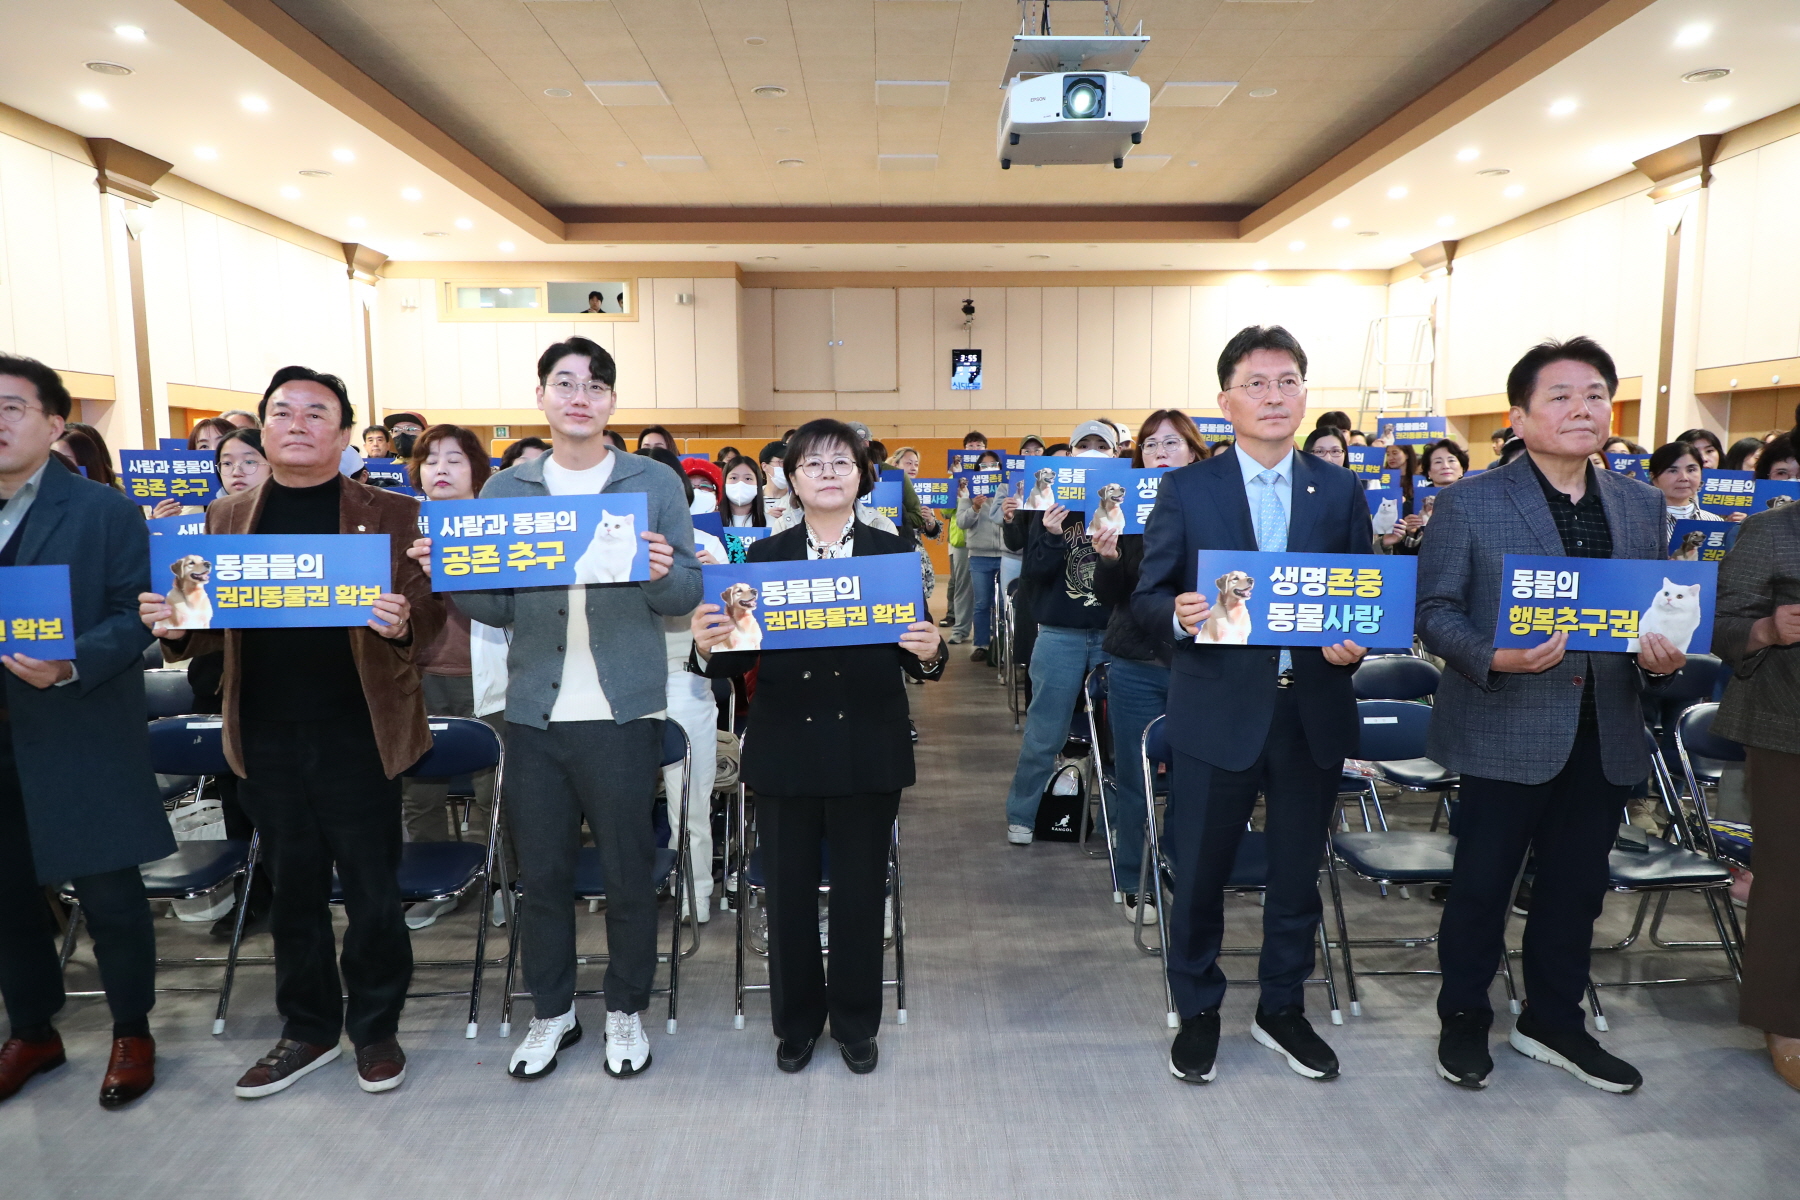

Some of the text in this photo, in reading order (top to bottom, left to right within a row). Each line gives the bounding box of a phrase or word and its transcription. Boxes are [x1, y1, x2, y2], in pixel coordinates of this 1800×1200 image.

[1199, 423, 1233, 433] 동물들의
[128, 459, 216, 474] 사람과 동물의
[131, 478, 167, 497] 공존
[170, 478, 210, 497] 추구
[913, 482, 949, 493] 생명존중
[1705, 478, 1755, 494] 동물들의
[439, 513, 509, 538] 사람과
[512, 510, 577, 535] 동물의
[215, 553, 325, 581] 동물들의
[442, 540, 567, 576] 공존 추구
[761, 575, 861, 606] 동물들의
[1269, 566, 1383, 598] 생명존중
[1511, 569, 1580, 600] 동물의
[216, 584, 382, 609] 권리동물권 확보
[11, 617, 65, 641] 확보
[763, 602, 917, 632] 권리동물권 확보
[1267, 602, 1384, 634] 동물사랑
[1509, 605, 1640, 638] 행복추구권
